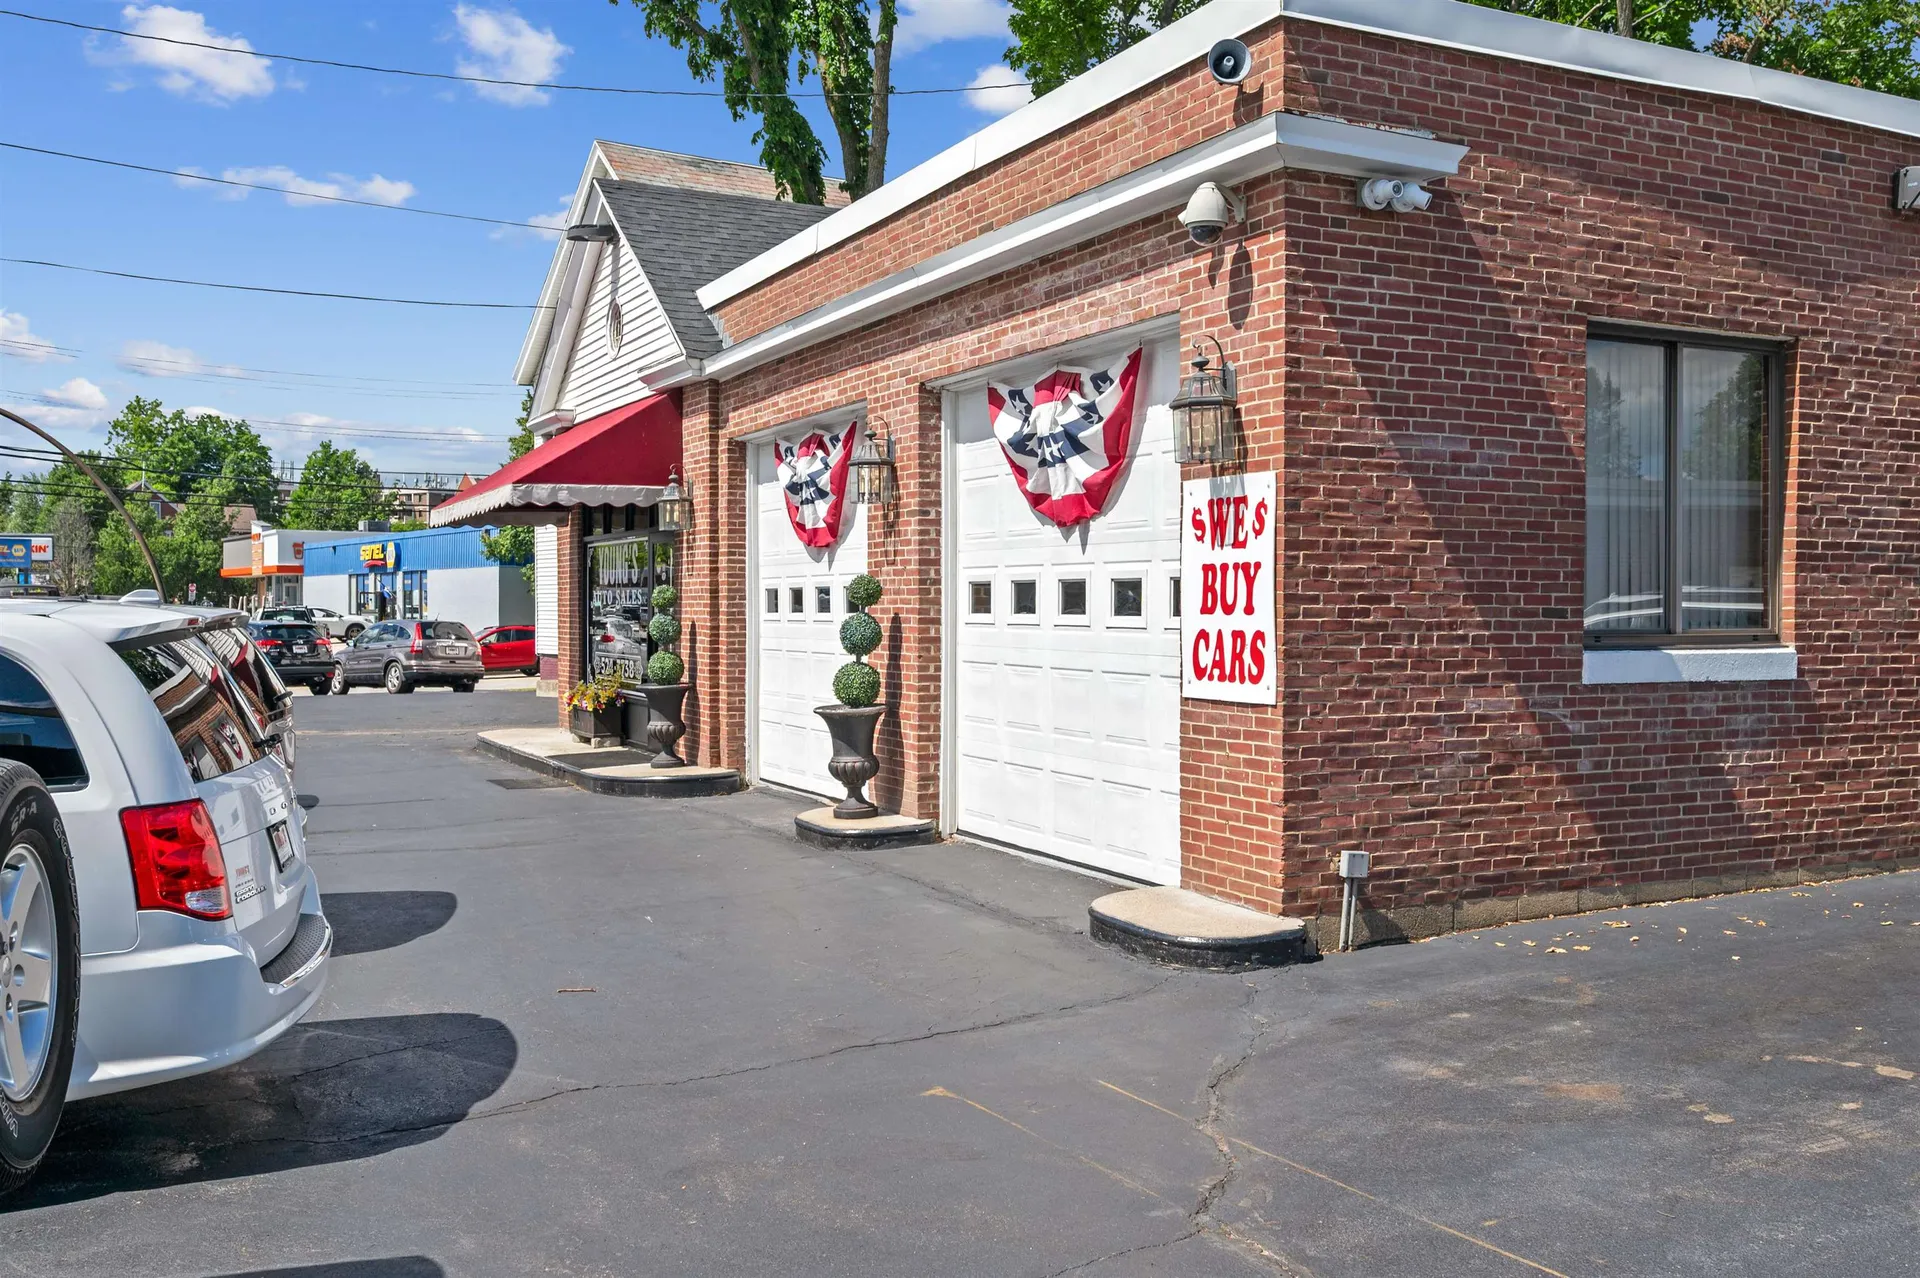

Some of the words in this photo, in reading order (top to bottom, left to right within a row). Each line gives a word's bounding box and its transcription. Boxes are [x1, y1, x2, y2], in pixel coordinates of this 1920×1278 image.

[599, 543, 638, 585] YOUNG'S
[593, 589, 612, 605] AUTO
[616, 589, 642, 605] SALES
[1200, 561, 1262, 616] BUY
[1192, 628, 1266, 685] CARS
